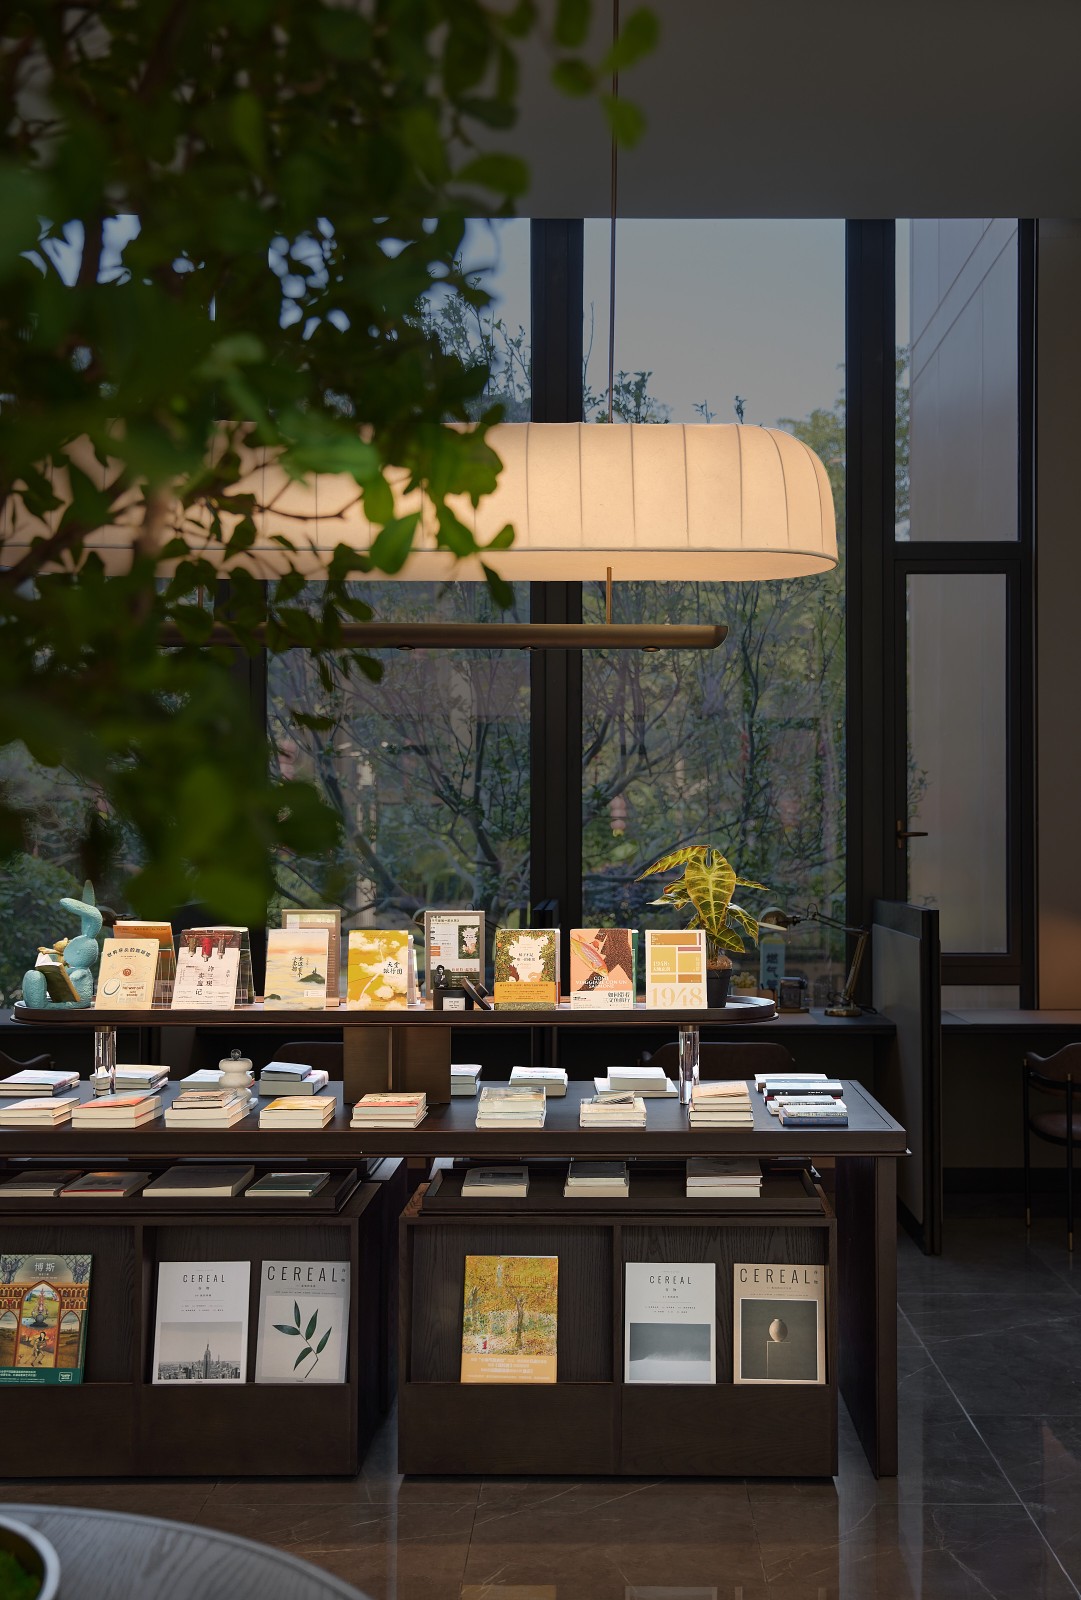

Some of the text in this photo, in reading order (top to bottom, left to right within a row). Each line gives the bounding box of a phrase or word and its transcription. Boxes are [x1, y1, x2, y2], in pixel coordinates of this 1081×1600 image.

[650, 987, 703, 1008] 1948
[34, 1262, 55, 1272] 博斯
[267, 1265, 338, 1282] CEREAL
[182, 1274, 225, 1283] CEREAL
[649, 1275, 692, 1285] CEREAL
[740, 1268, 811, 1285] CEREAL
